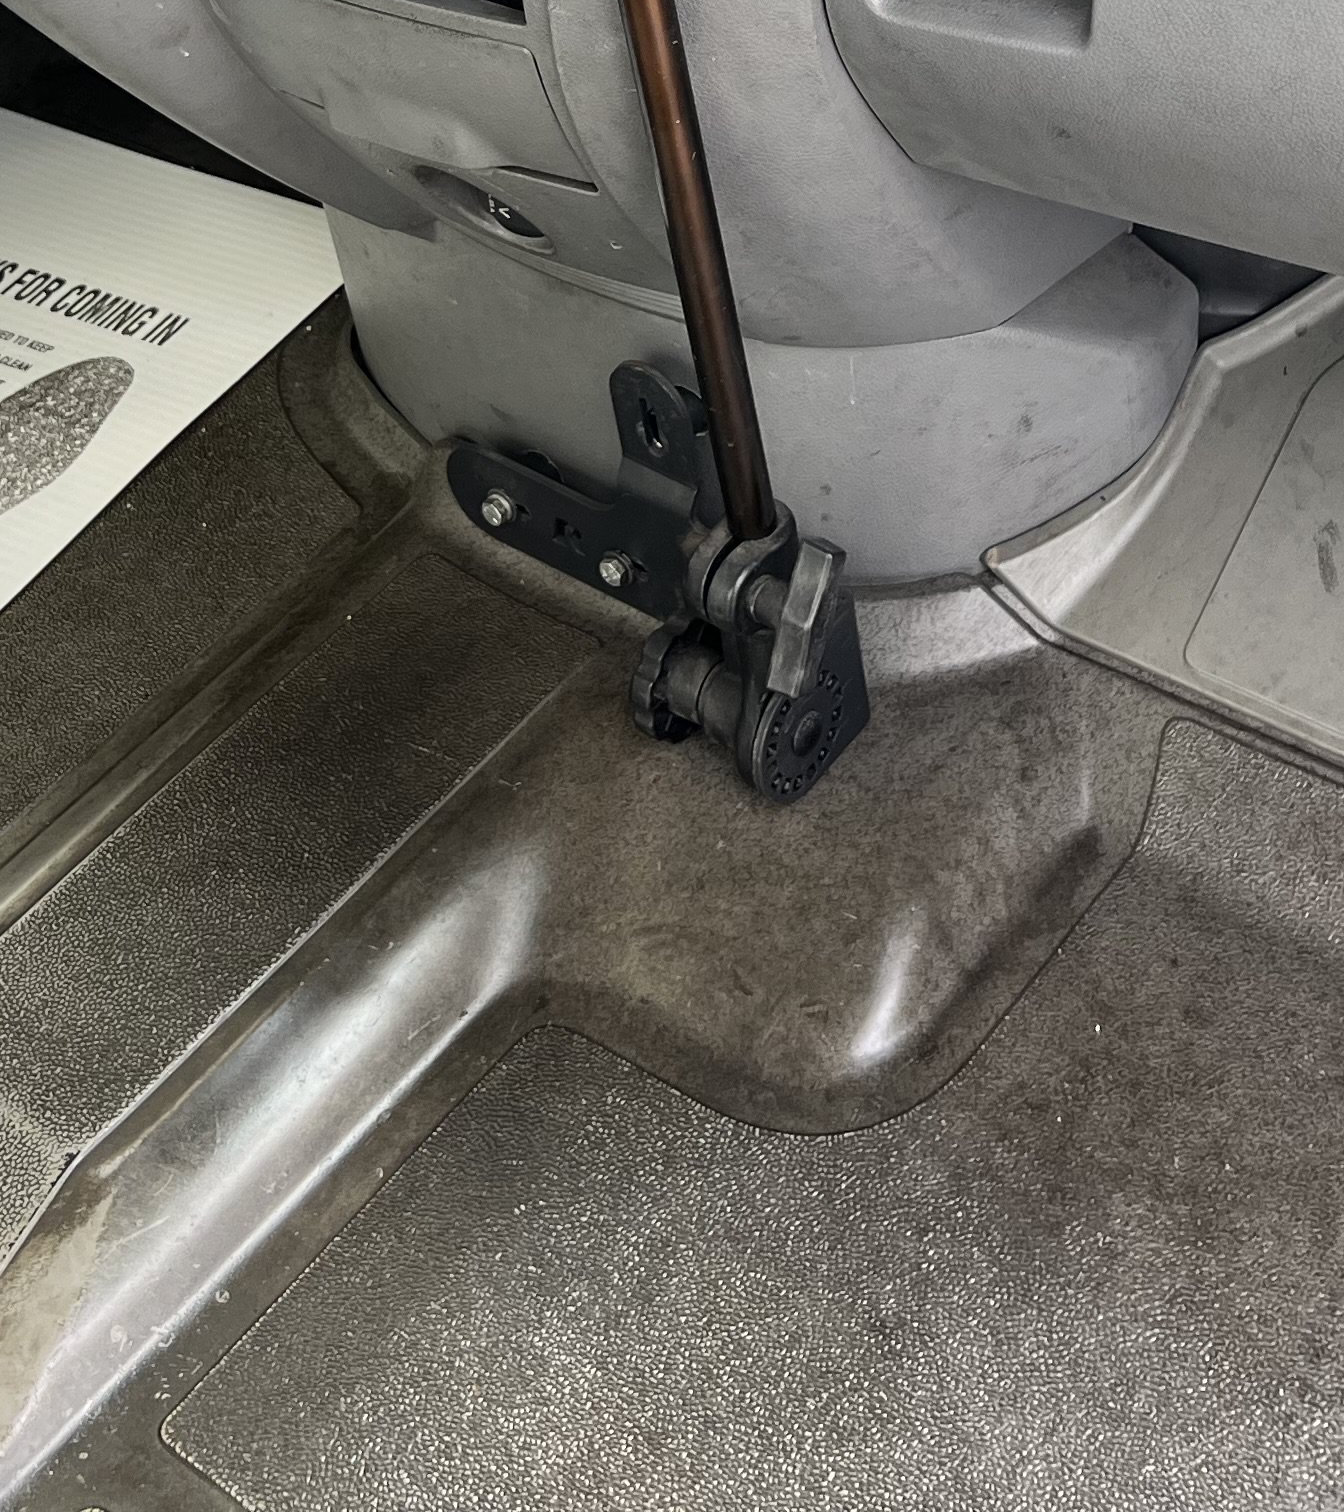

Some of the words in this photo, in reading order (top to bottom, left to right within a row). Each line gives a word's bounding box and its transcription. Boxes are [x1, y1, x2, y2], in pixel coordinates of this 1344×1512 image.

[1, 268, 67, 307] FOR
[50, 284, 159, 337] COMING
[141, 312, 190, 346] IN
[13, 334, 30, 346] TO
[26, 340, 55, 353] KEEP
